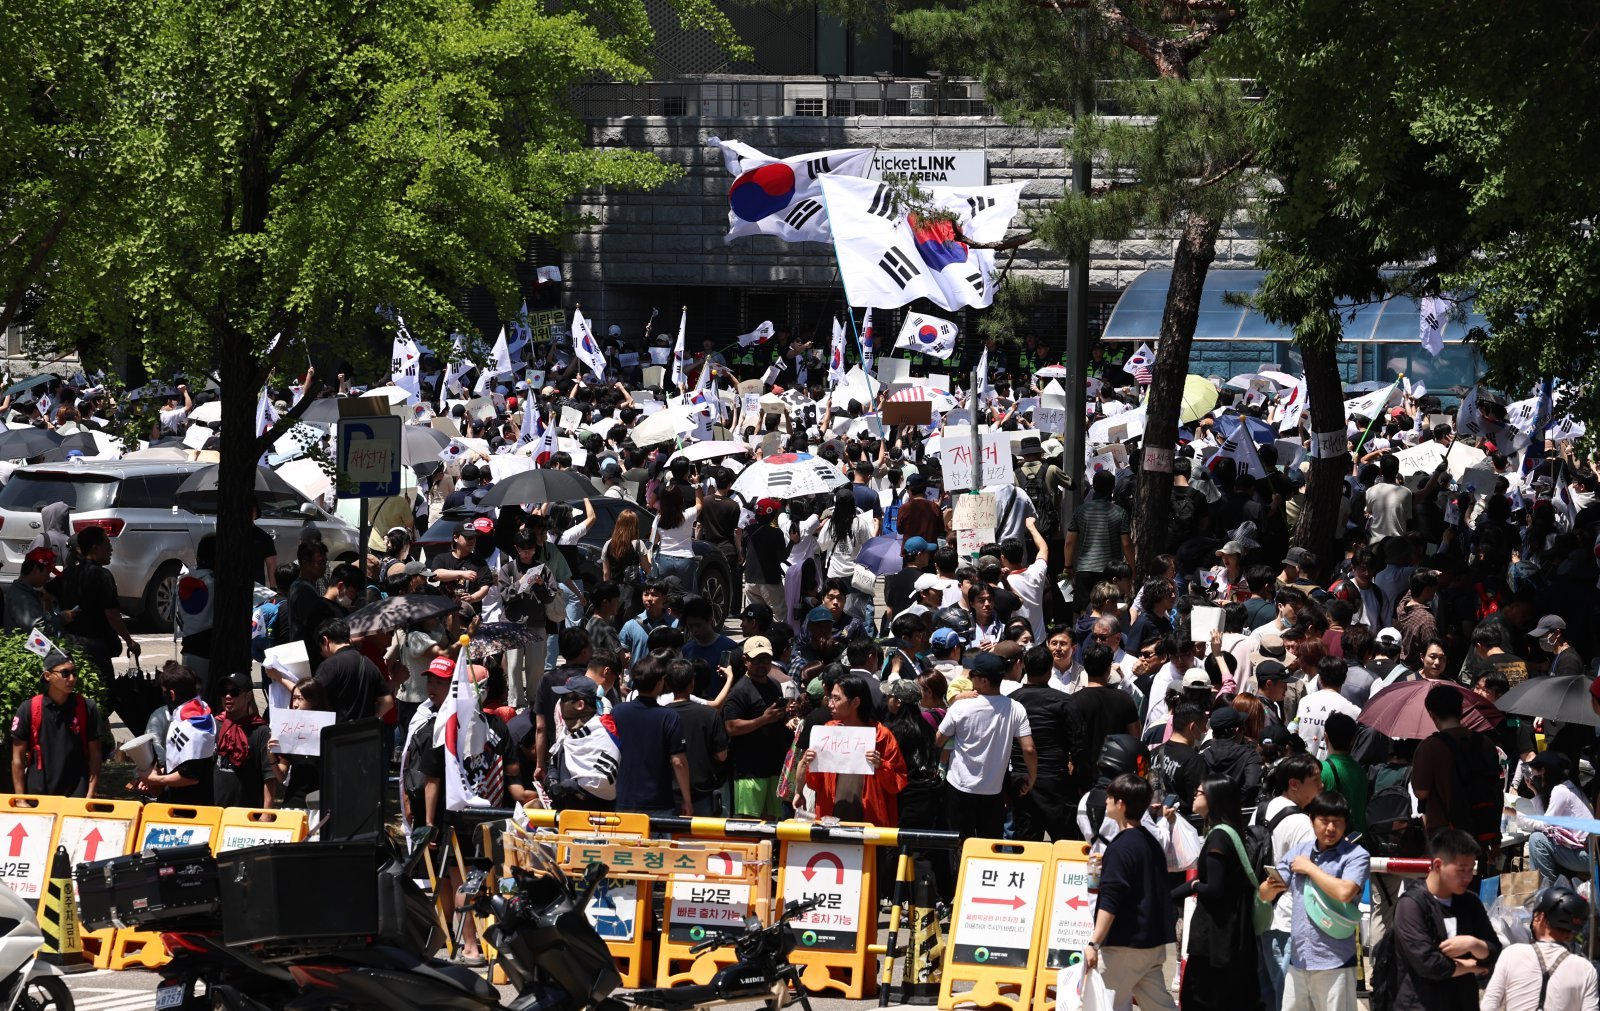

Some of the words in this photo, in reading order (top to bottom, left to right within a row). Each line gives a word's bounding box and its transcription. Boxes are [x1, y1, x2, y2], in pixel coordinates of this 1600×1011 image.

[874, 156, 956, 170] ticketLINK
[909, 171, 947, 182] ARENA
[352, 447, 387, 473] 재선거
[948, 442, 998, 466] 재거
[820, 735, 866, 755] 재선거
[580, 849, 696, 869] 도로청소
[20, 882, 37, 893] 가능
[691, 887, 731, 905] 남2문
[64, 896, 75, 949] 주차금지
[677, 907, 697, 918] 빠른
[699, 908, 721, 919] 출차
[722, 910, 741, 920] 가능
[811, 913, 831, 924] 출차
[833, 914, 852, 926] 가능
